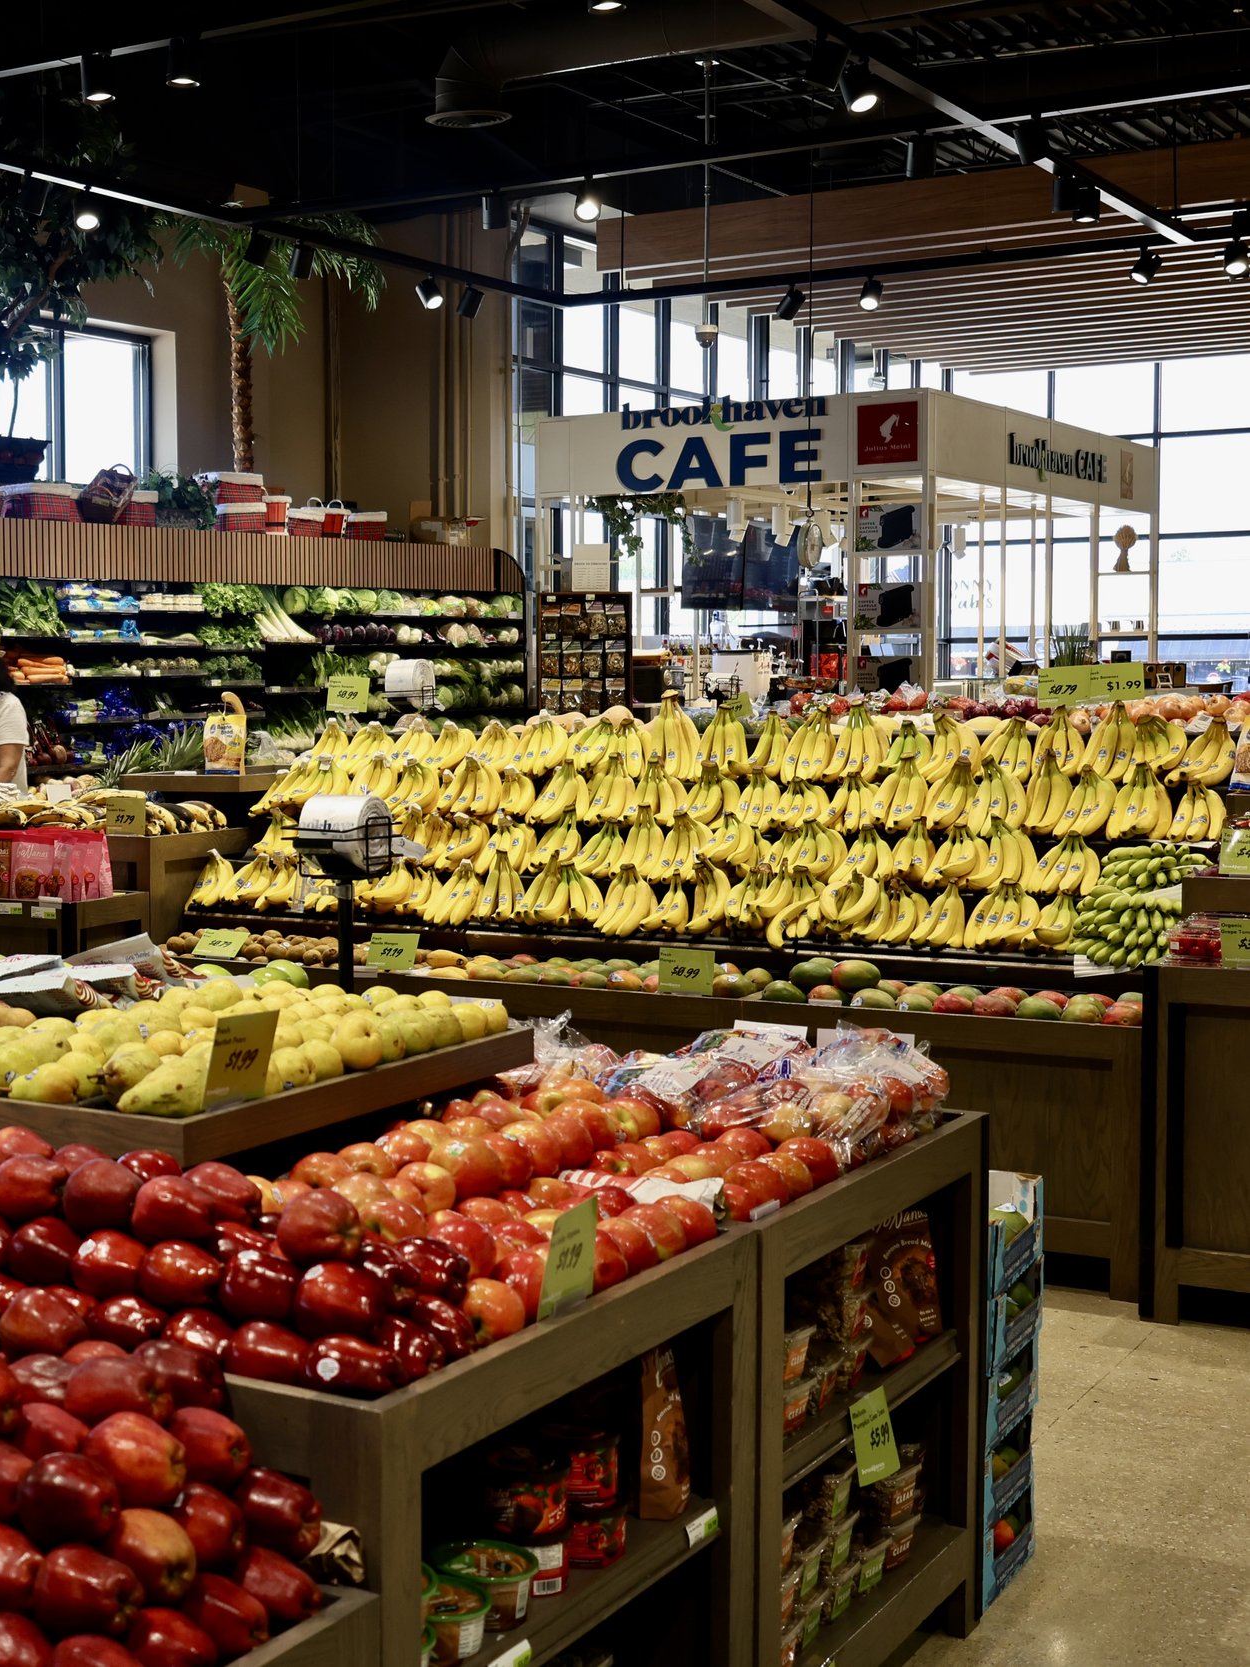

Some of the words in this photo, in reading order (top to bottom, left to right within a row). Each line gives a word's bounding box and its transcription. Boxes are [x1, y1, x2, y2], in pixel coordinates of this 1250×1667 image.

[622, 394, 828, 432] brookhaven
[616, 428, 822, 492] CAFE
[1008, 432, 1074, 482] brookhaven
[1075, 448, 1107, 483] CAFE
[1048, 684, 1078, 696] $0.79
[1107, 680, 1141, 692] $1.99
[337, 690, 358, 700] $0.99
[115, 814, 135, 824] $1.79
[380, 947, 404, 958] $1.19
[671, 966, 700, 979] $0.99
[224, 1048, 258, 1071] $1.99
[900, 1238, 919, 1247] Bread
[920, 1240, 932, 1249] Mix
[870, 1421, 890, 1451] $5.99
